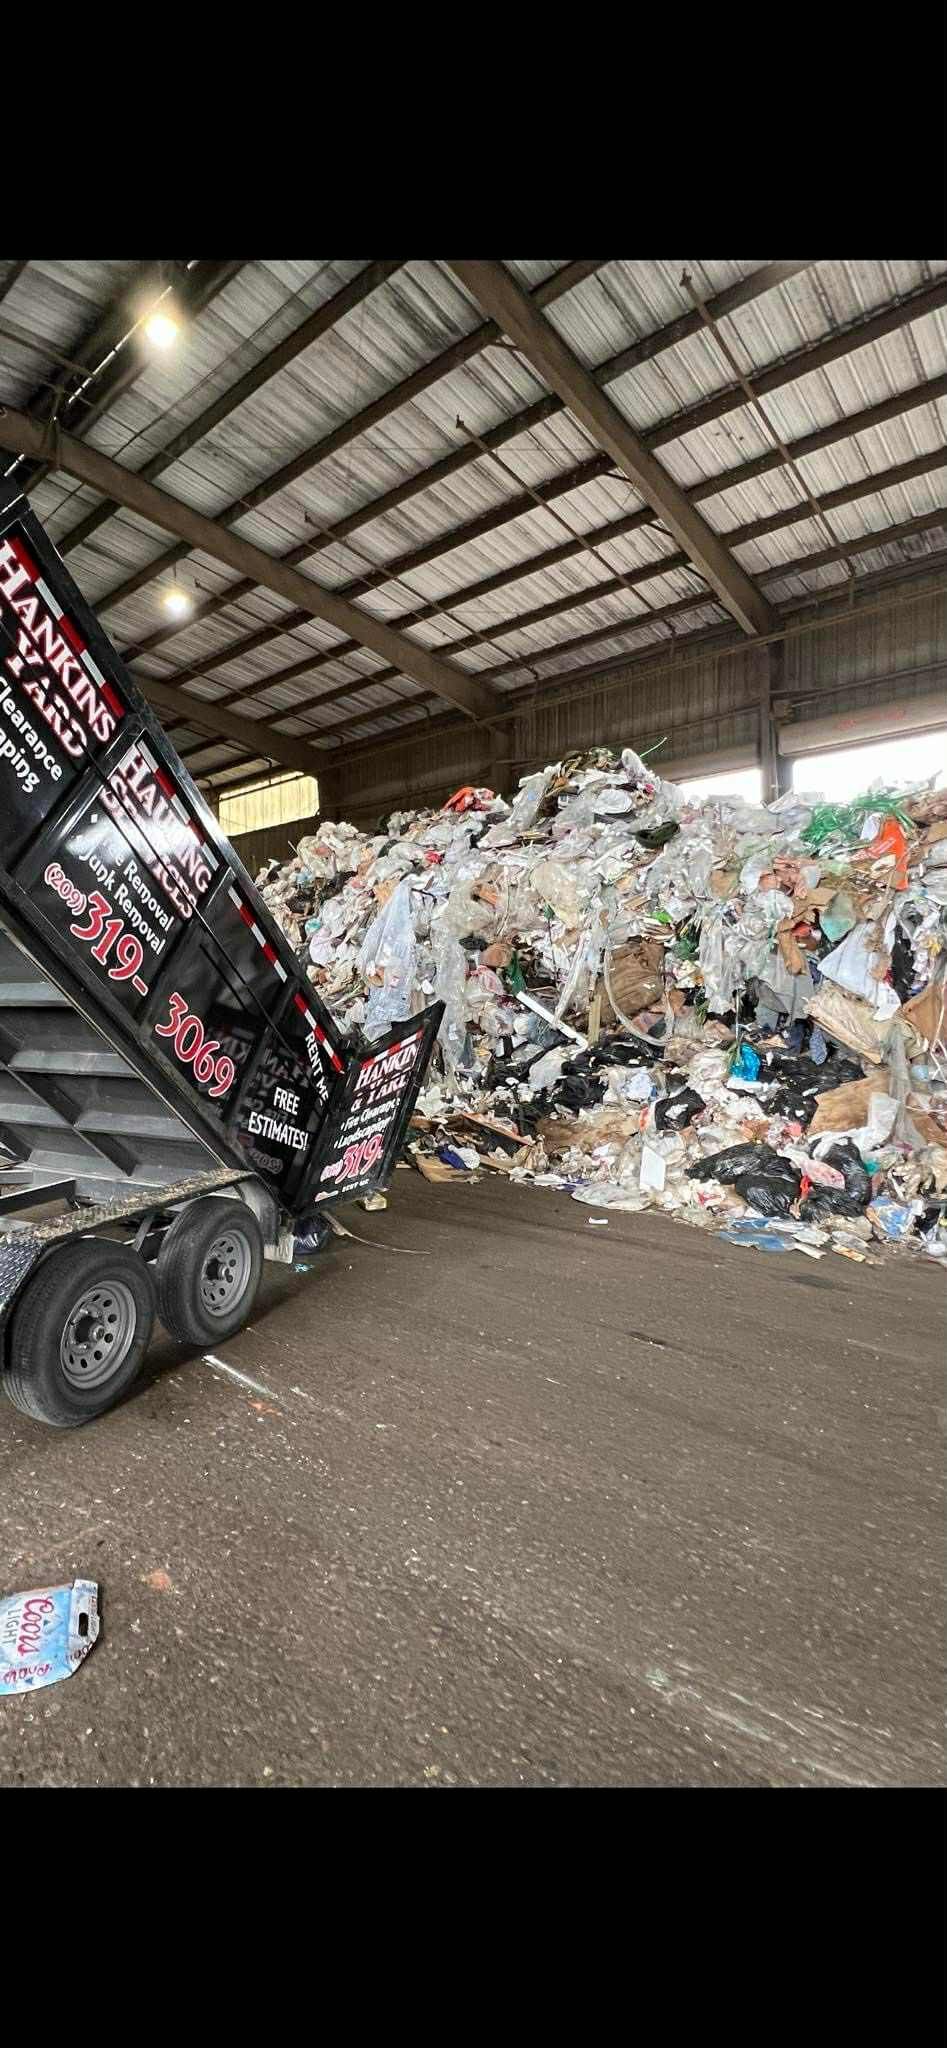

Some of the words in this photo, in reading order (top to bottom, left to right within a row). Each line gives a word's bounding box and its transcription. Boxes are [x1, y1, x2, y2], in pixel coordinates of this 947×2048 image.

[0, 539, 117, 742] HANKINS
[101, 775, 198, 919] SEICES
[118, 745, 212, 893] HAUNG
[44, 862, 87, 916] (209)
[114, 884, 166, 955] Removal
[123, 859, 175, 932] Removal
[155, 991, 235, 1097] 3069
[305, 1030, 323, 1076] RENT
[316, 1076, 329, 1106] ME
[354, 1043, 417, 1092] HANKIN
[247, 1111, 309, 1152] ESTIMATES!
[273, 1086, 301, 1115] FREE
[1, 1608, 20, 1645] LIGHT
[17, 1595, 55, 1657] Coors
